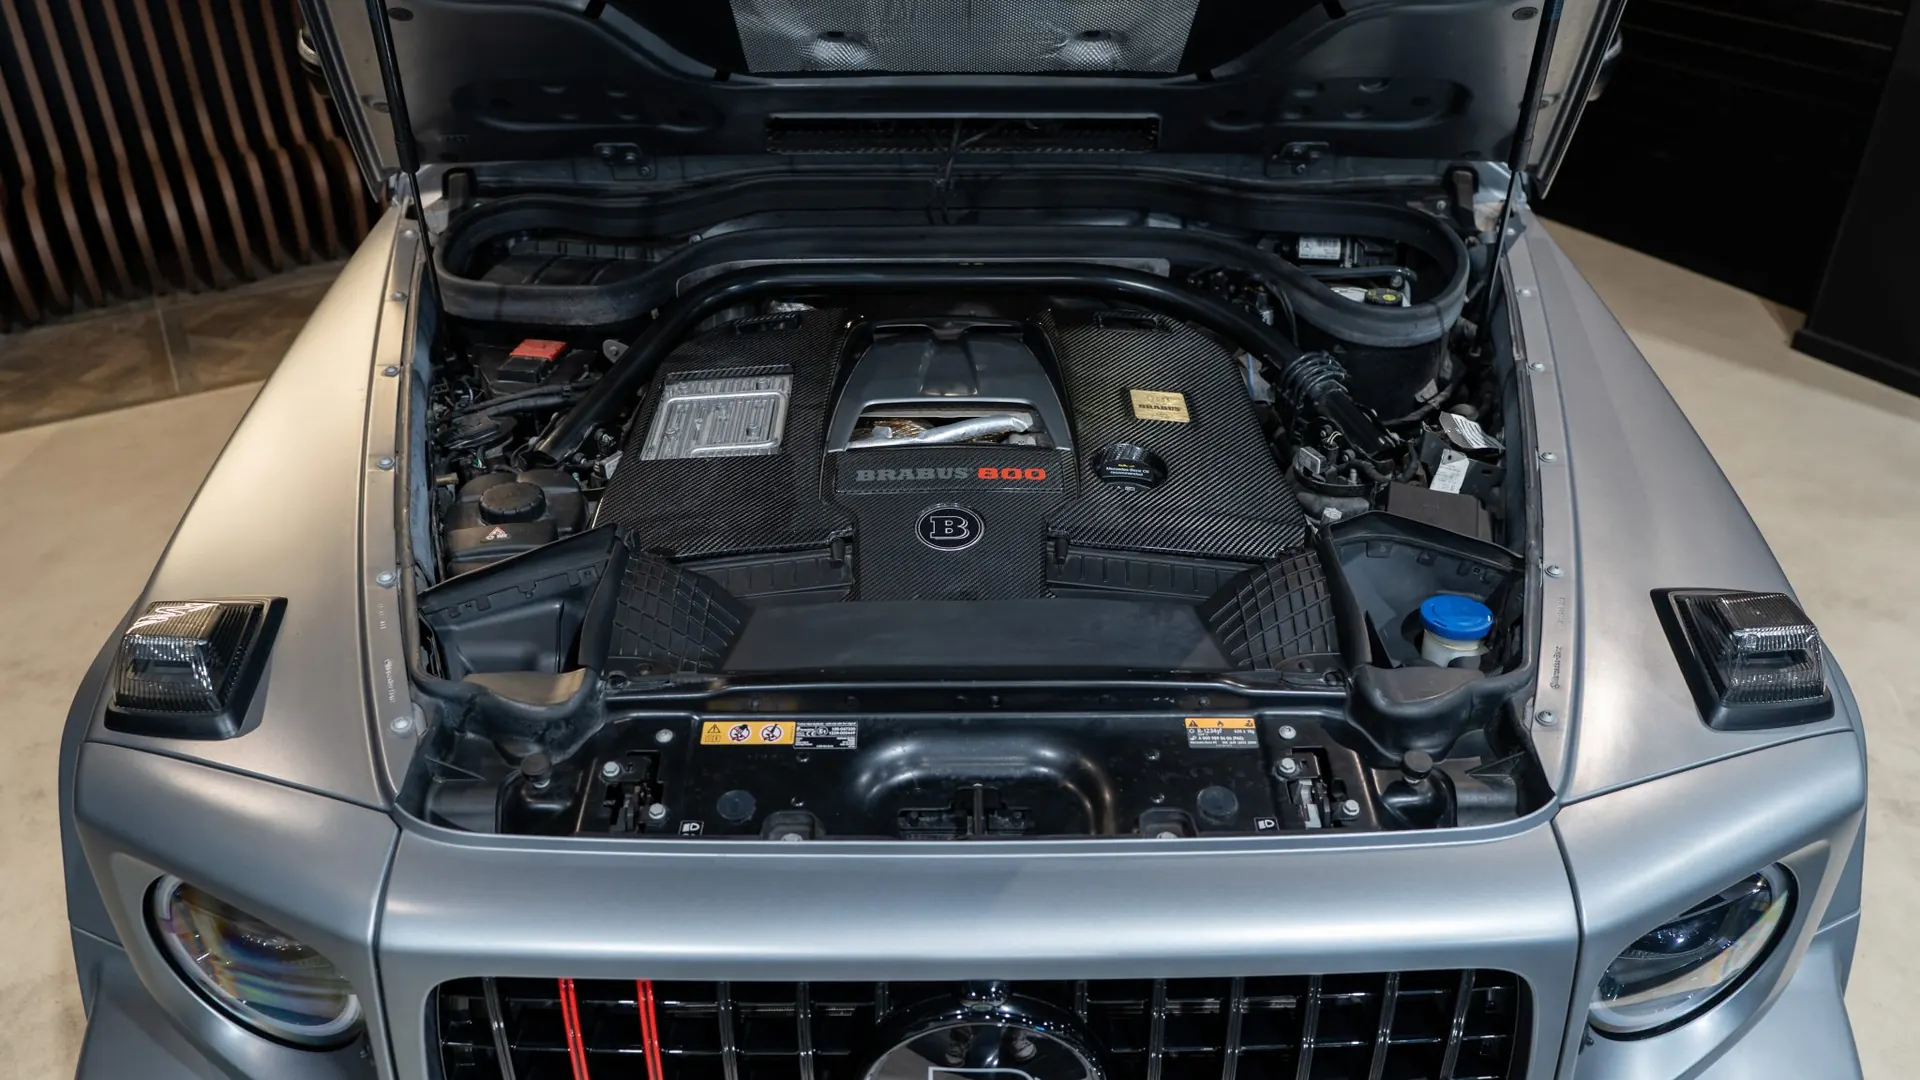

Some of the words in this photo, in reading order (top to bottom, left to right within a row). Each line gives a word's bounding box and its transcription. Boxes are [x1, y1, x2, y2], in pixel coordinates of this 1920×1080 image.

[856, 467, 969, 482] BRABUS
[977, 467, 1047, 481] 800
[929, 515, 970, 540] B
